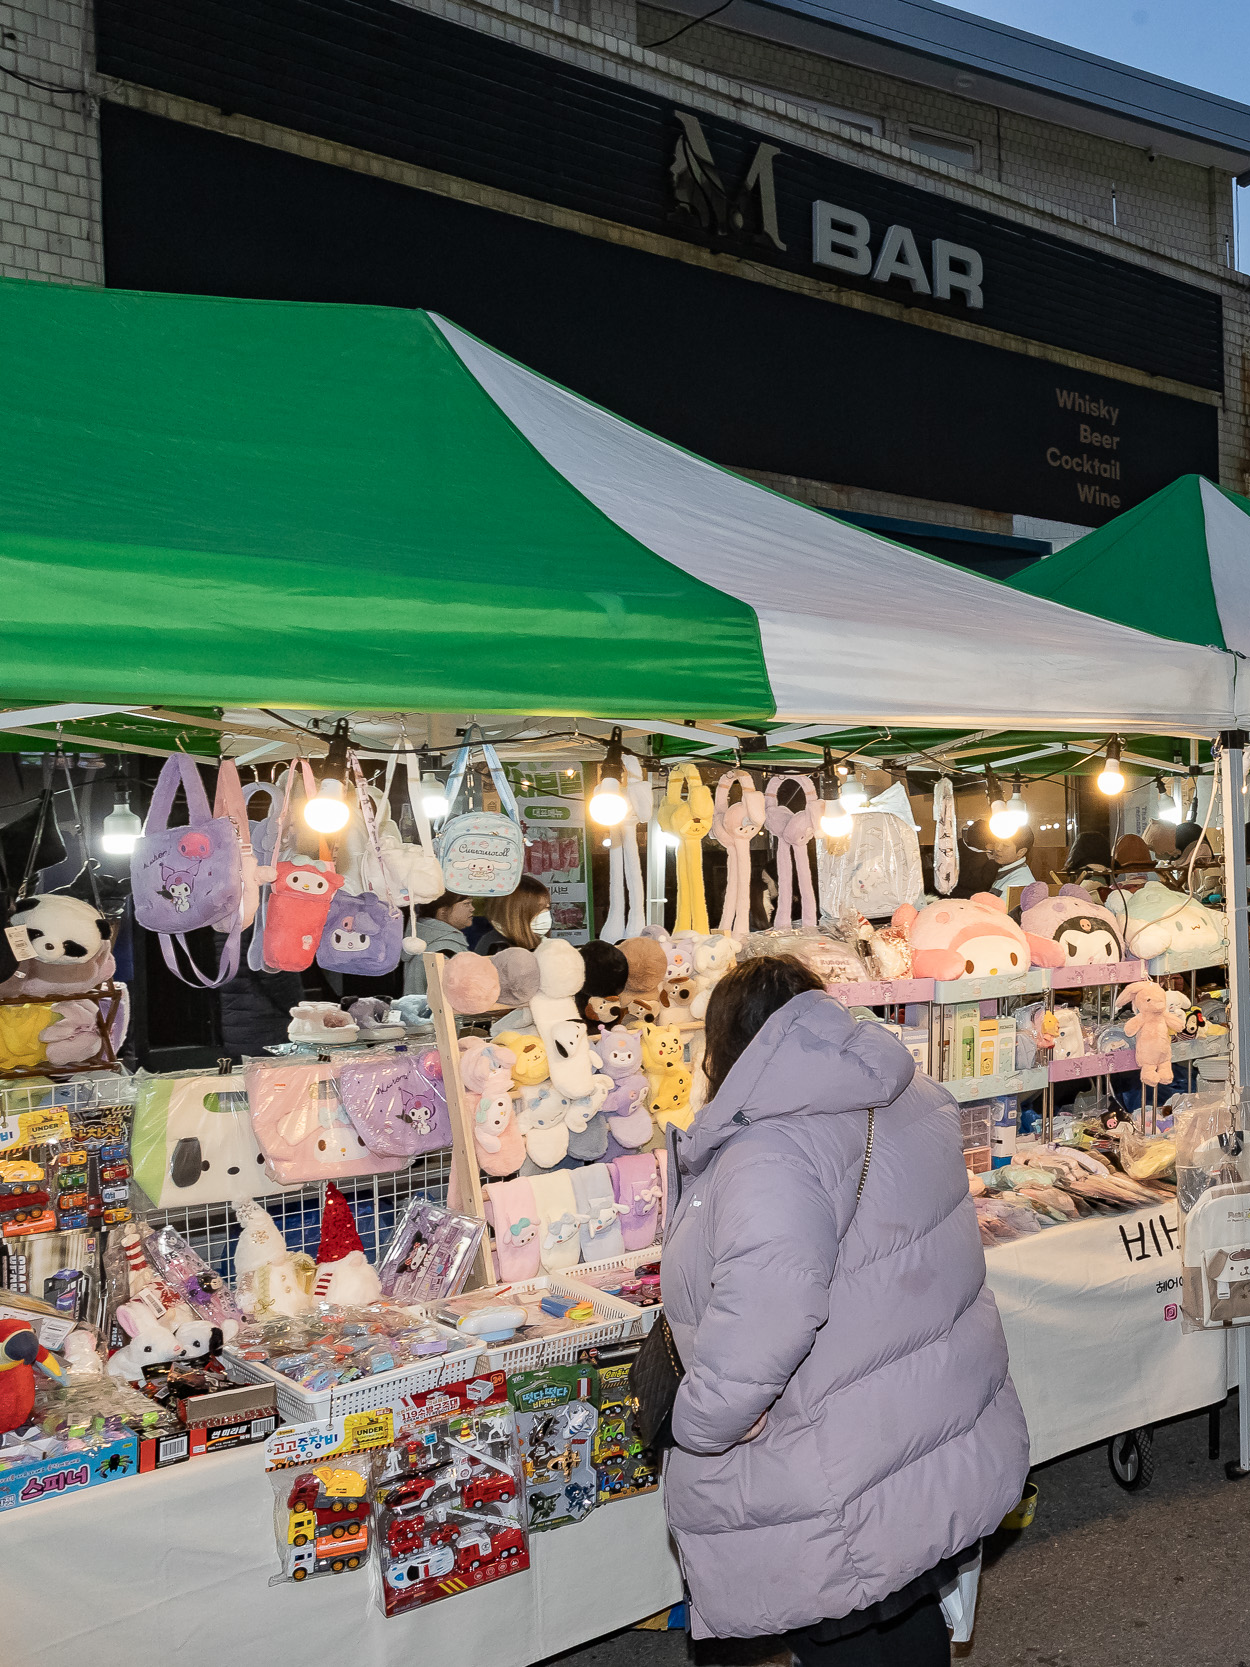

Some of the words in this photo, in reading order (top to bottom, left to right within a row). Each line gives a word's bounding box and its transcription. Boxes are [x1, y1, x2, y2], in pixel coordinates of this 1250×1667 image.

[812, 199, 984, 309] BAR
[1055, 387, 1119, 426] Whisky
[1079, 424, 1120, 451] Beer
[1046, 447, 1121, 482] Cocktail
[1077, 483, 1121, 510] Wine
[31, 1122, 59, 1133] UNDER
[356, 1425, 384, 1437] UNDER
[20, 1465, 89, 1501] 스피너
